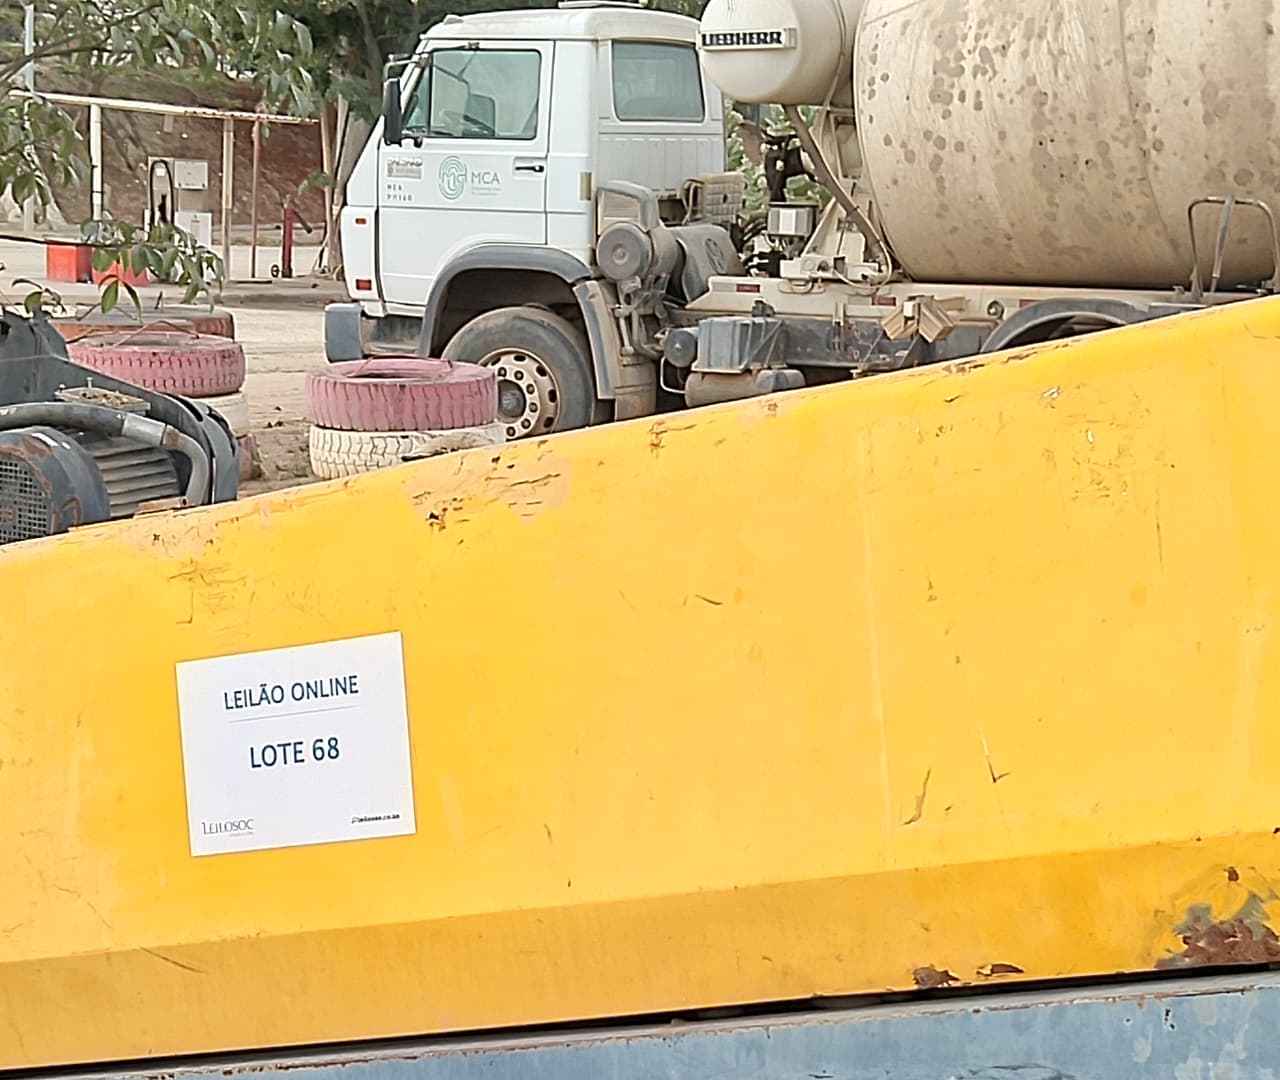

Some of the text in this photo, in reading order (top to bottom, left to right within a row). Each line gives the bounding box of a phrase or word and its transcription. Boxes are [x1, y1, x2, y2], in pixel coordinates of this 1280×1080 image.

[701, 31, 783, 47] LIEBHERR
[470, 171, 502, 185] MCA
[223, 674, 360, 711] LEILÃO ONLINE
[249, 736, 341, 769] LOTE 68
